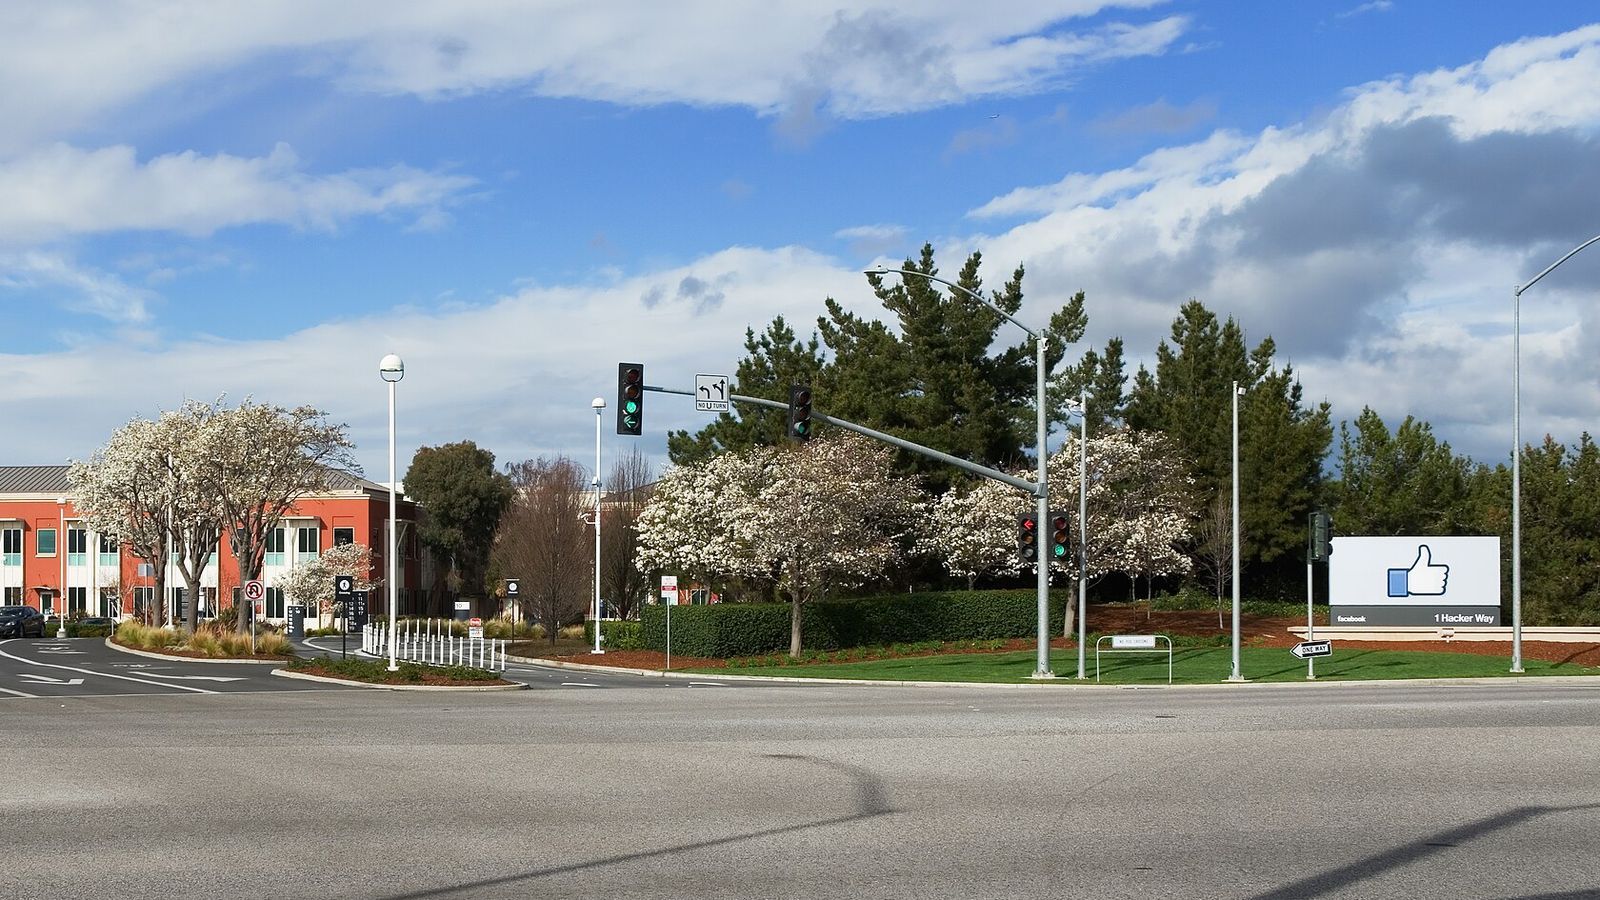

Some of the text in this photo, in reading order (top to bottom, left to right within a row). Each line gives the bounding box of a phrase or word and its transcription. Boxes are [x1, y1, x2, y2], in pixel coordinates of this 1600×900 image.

[1434, 613, 1494, 624] 1 Hacker Way
